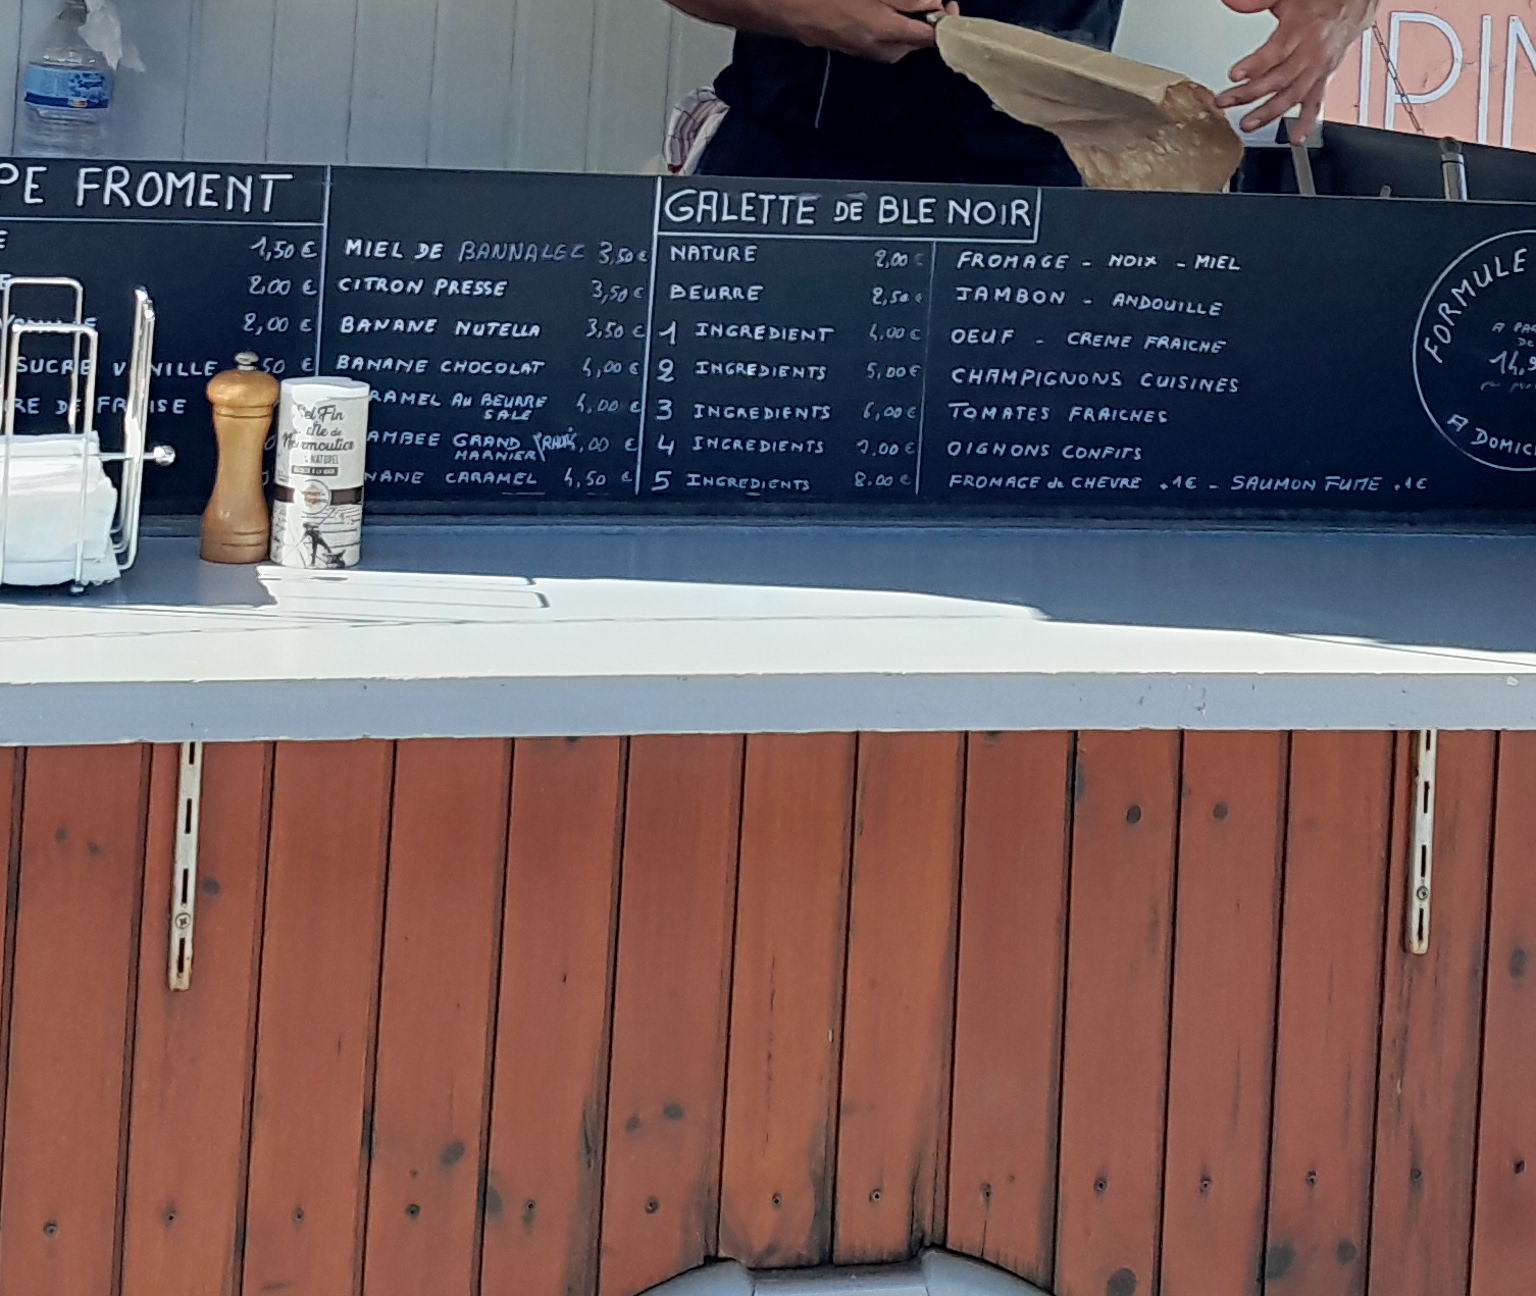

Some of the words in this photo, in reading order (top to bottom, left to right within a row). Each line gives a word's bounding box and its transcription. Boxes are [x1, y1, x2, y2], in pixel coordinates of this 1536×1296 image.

[76, 165, 294, 214] FROMENT
[664, 189, 817, 226] GALETTE
[833, 200, 864, 223] DE
[878, 196, 937, 225] BLE
[947, 198, 1032, 227] NOIR
[345, 239, 404, 260] MIEL
[414, 243, 444, 260] DE
[670, 245, 758, 263] NATURE
[957, 252, 1070, 271] FROMAGE
[1108, 255, 1158, 268] NOIX
[1195, 255, 1242, 271] MIEL
[338, 277, 424, 295] CITRON
[434, 279, 508, 298] PRESSE
[670, 284, 764, 302] BEURRE
[955, 285, 1066, 305] JAMBON
[1112, 293, 1223, 316] ANDOUILLE
[1424, 248, 1528, 364] FORMULE
[340, 315, 439, 335] BANANE
[455, 321, 542, 338] NUTELLA
[659, 320, 678, 345] 1
[695, 322, 836, 342] INGREDIENT
[951, 329, 1015, 345] OEUF
[1066, 332, 1132, 349] CREME
[1143, 335, 1228, 354] FRAICHE
[113, 361, 218, 377] VNILLE
[336, 354, 429, 373] BANANE
[440, 360, 546, 375] CHOCOLAT
[657, 359, 675, 383] 2
[695, 360, 827, 381] INGREDIENTS
[951, 367, 1123, 387] CHAMPIGNONS
[1140, 372, 1240, 393] CUISINES
[367, 390, 442, 407] RAMEL
[479, 393, 548, 409] BEURRE
[656, 399, 673, 421] 3
[693, 403, 831, 420] INGREDIENTS
[317, 405, 345, 422] Fin
[481, 409, 534, 422] SALE
[948, 402, 1051, 422] TOMATES
[1068, 407, 1169, 424] FRAICHES
[1447, 413, 1470, 432] A
[367, 430, 442, 448] AMBEE
[452, 432, 522, 450] GRAND
[657, 434, 675, 456] 4
[692, 435, 825, 454] INGREDIENTS
[454, 449, 537, 462] MARNIER
[947, 441, 1051, 457] OIGNONS
[1061, 444, 1142, 461] CONFITS
[364, 469, 425, 484] NANE
[445, 470, 538, 485] CARAMEL
[651, 470, 673, 492] 5
[685, 472, 811, 492] INGREDIENTS
[948, 474, 1042, 489] FROMAGE
[1071, 475, 1143, 490] CHEVRE
[1230, 475, 1317, 492] SAUMON
[1325, 475, 1384, 492] FUME
